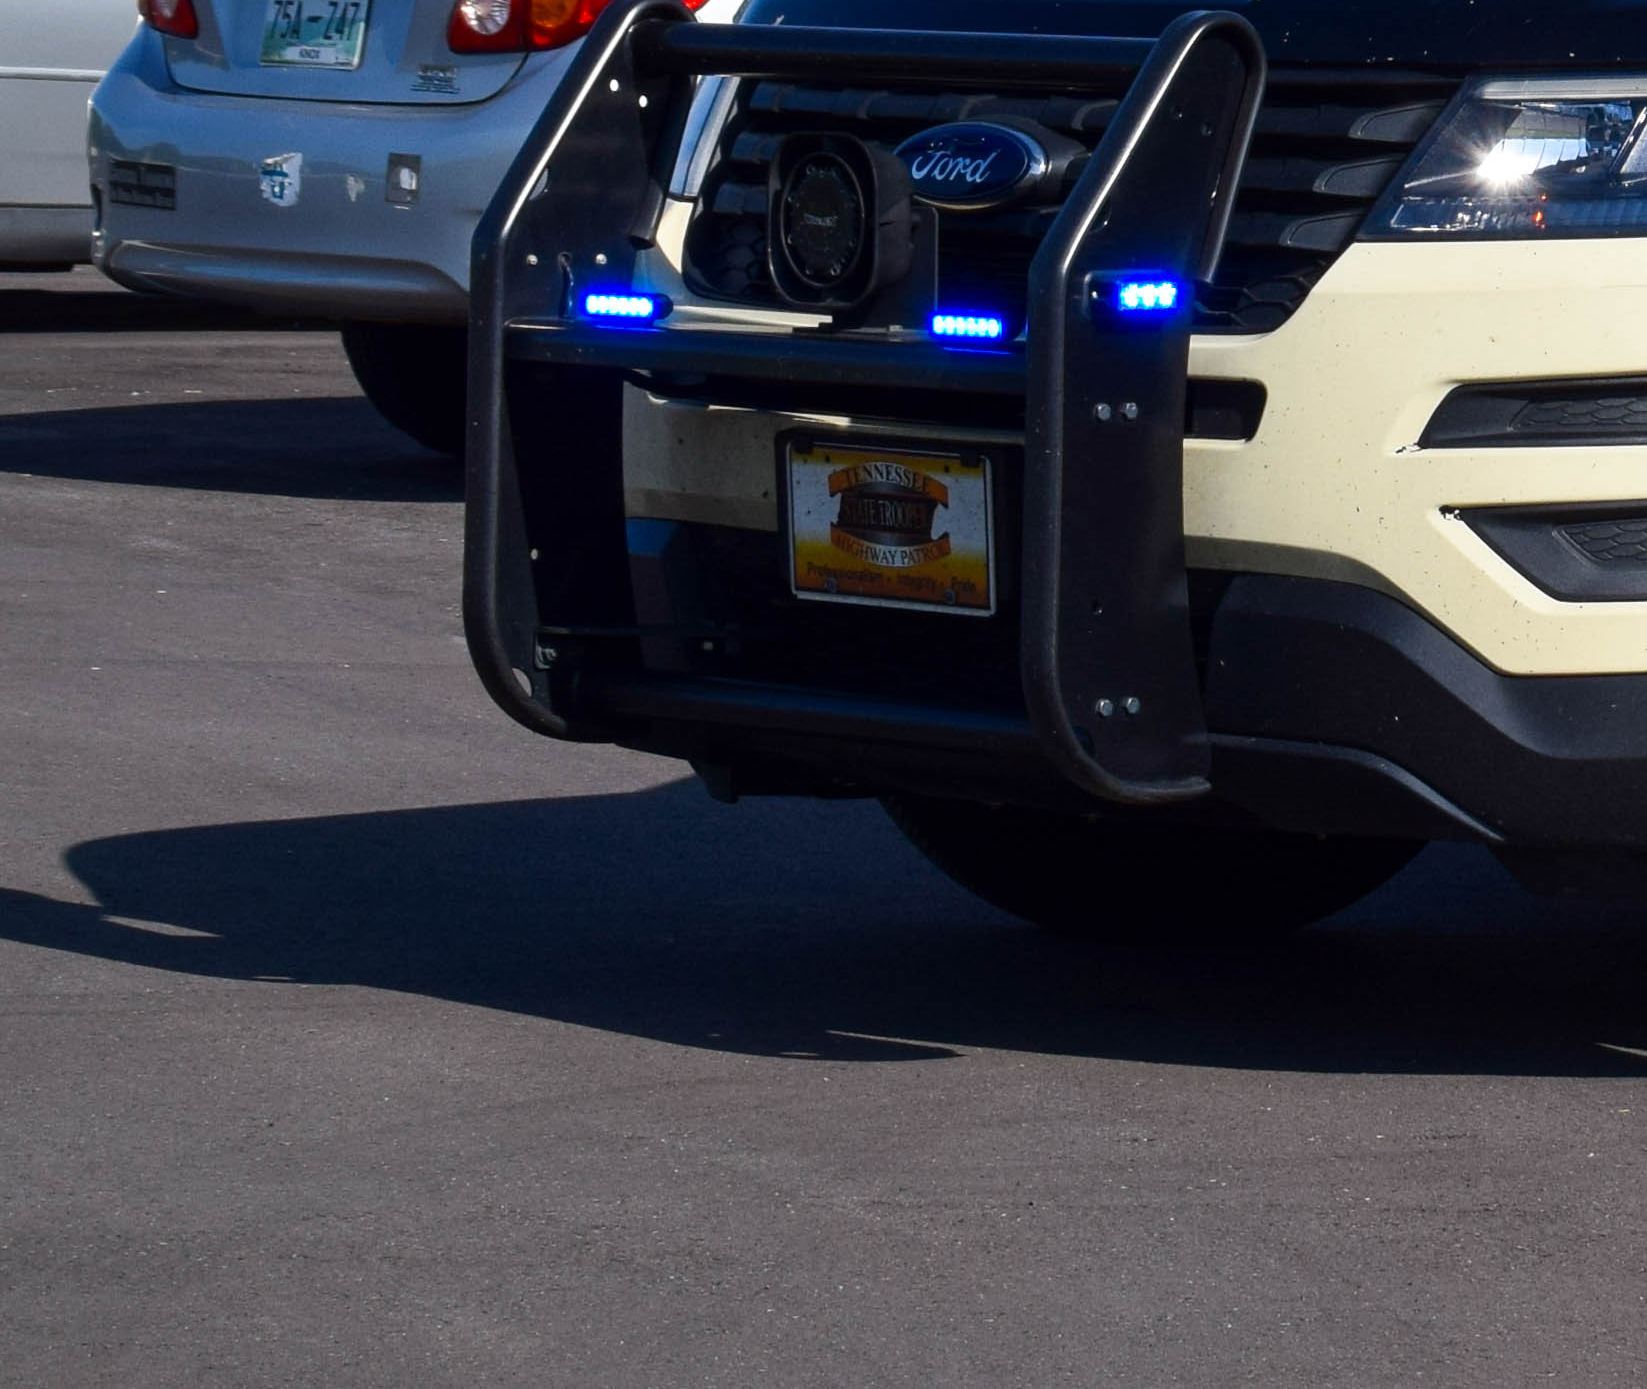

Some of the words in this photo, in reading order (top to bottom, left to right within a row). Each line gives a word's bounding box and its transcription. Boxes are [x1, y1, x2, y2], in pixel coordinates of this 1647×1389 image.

[910, 138, 1001, 184] Ford
[845, 463, 930, 491] TENNESSEE
[837, 534, 899, 565] HIGHWAY
